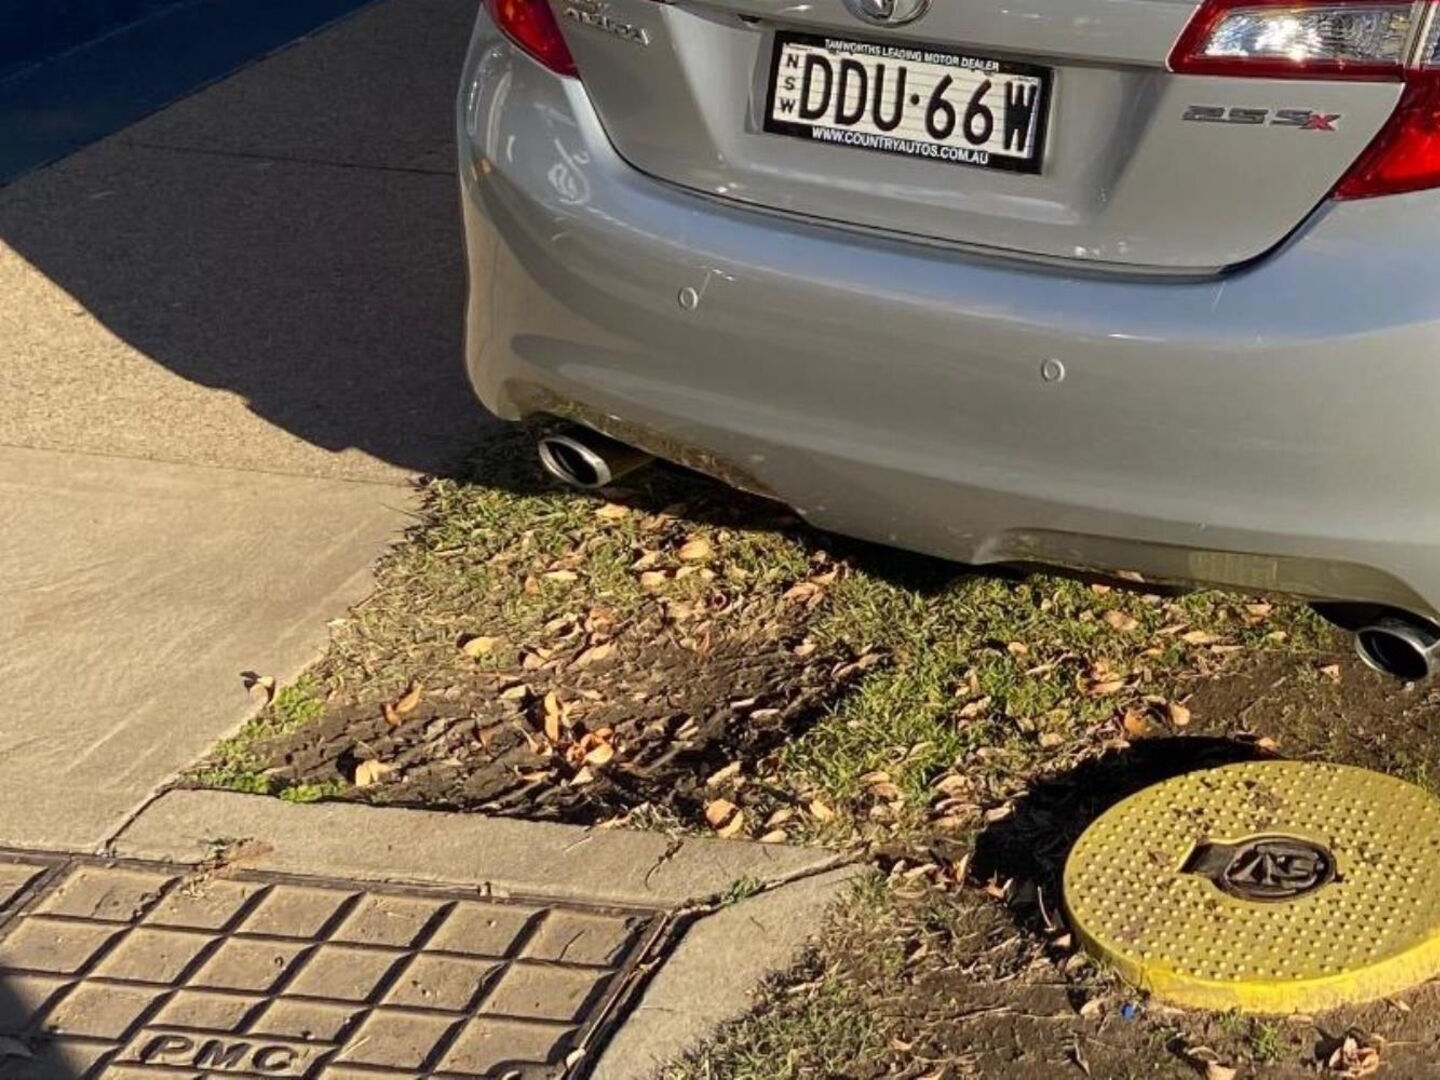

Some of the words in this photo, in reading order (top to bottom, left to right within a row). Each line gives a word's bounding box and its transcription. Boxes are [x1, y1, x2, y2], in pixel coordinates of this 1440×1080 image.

[882, 47, 922, 63] LEADING
[924, 52, 960, 67] MOTOR
[961, 56, 999, 72] DEALER
[811, 126, 989, 165] WWW.COUNTRYAUTOS.COM.AU
[139, 1033, 299, 1074] PMC
